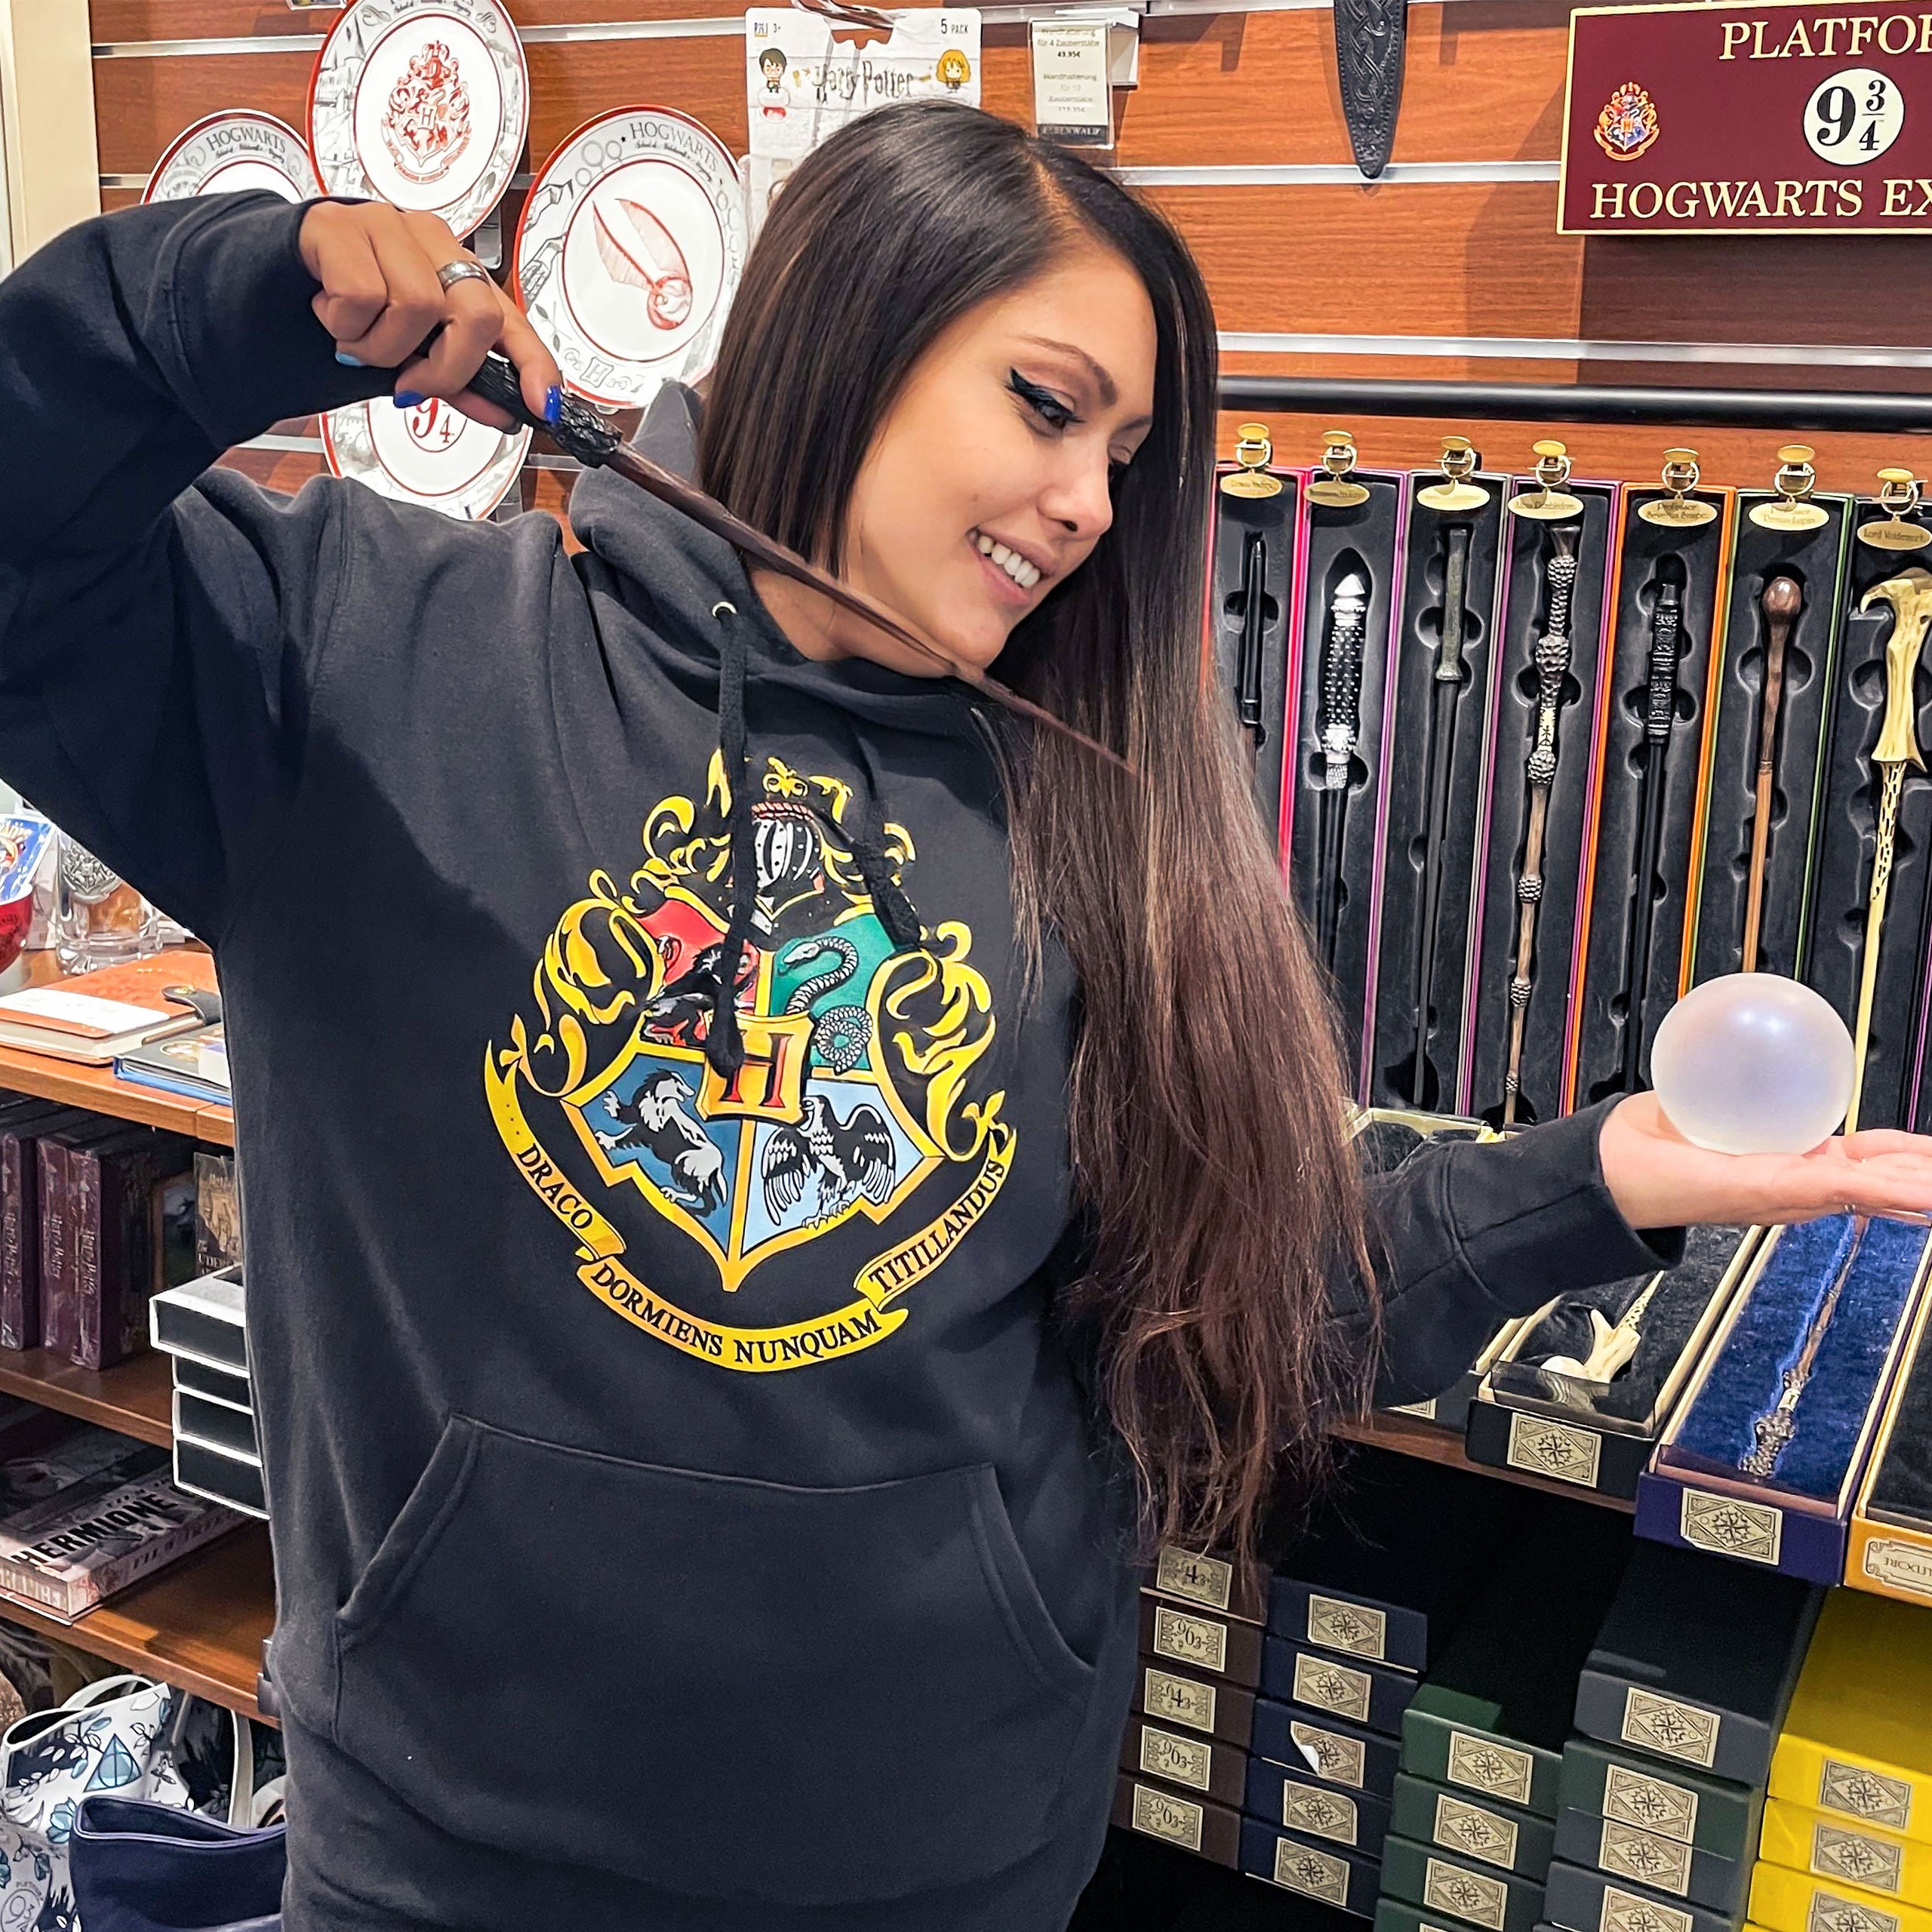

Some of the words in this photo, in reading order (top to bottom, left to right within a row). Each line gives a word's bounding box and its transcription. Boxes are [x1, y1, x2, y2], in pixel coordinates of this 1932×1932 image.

[940, 18, 948, 35] 5
[951, 24, 968, 35] PACK
[862, 60, 913, 105] Potter
[206, 126, 286, 154] HOGWARTS
[629, 122, 718, 172] HOGWARTS
[1589, 180, 1863, 219] HOGWARTS
[1879, 179, 1932, 216] EX
[516, 1144, 595, 1231] DRACO
[868, 1160, 1005, 1294] TITILLANDUS
[591, 1263, 724, 1356] DORMIENS
[734, 1309, 881, 1363] NUNQUAM
[11, 1494, 178, 1564] HERMIONE
